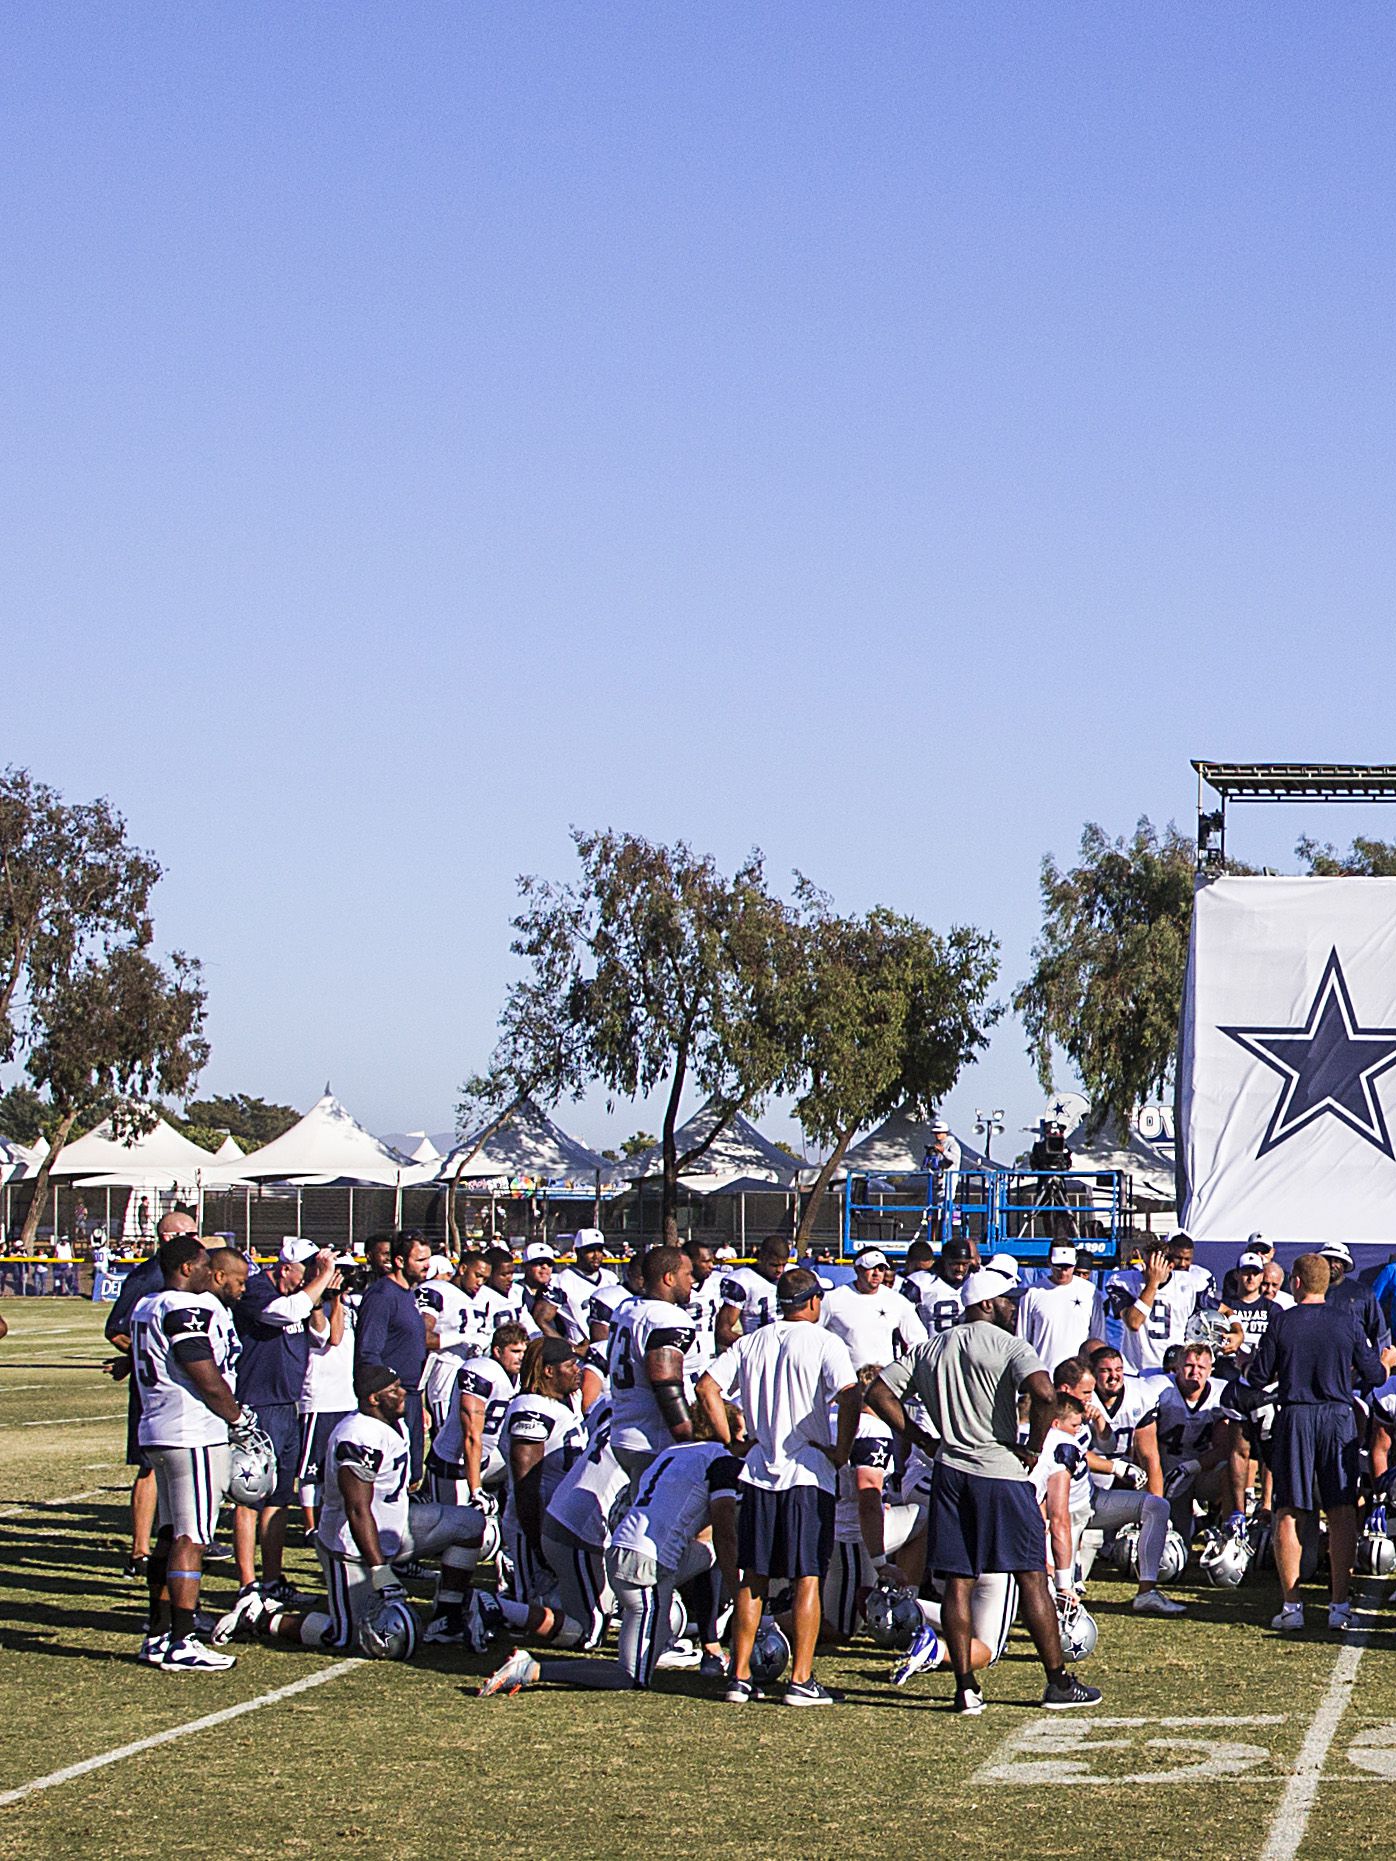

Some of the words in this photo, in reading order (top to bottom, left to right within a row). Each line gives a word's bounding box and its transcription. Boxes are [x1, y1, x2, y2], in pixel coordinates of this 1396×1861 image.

[1147, 1299, 1171, 1340] 9
[1233, 1309, 1268, 1321] ALLAS
[131, 1319, 159, 1388] 5
